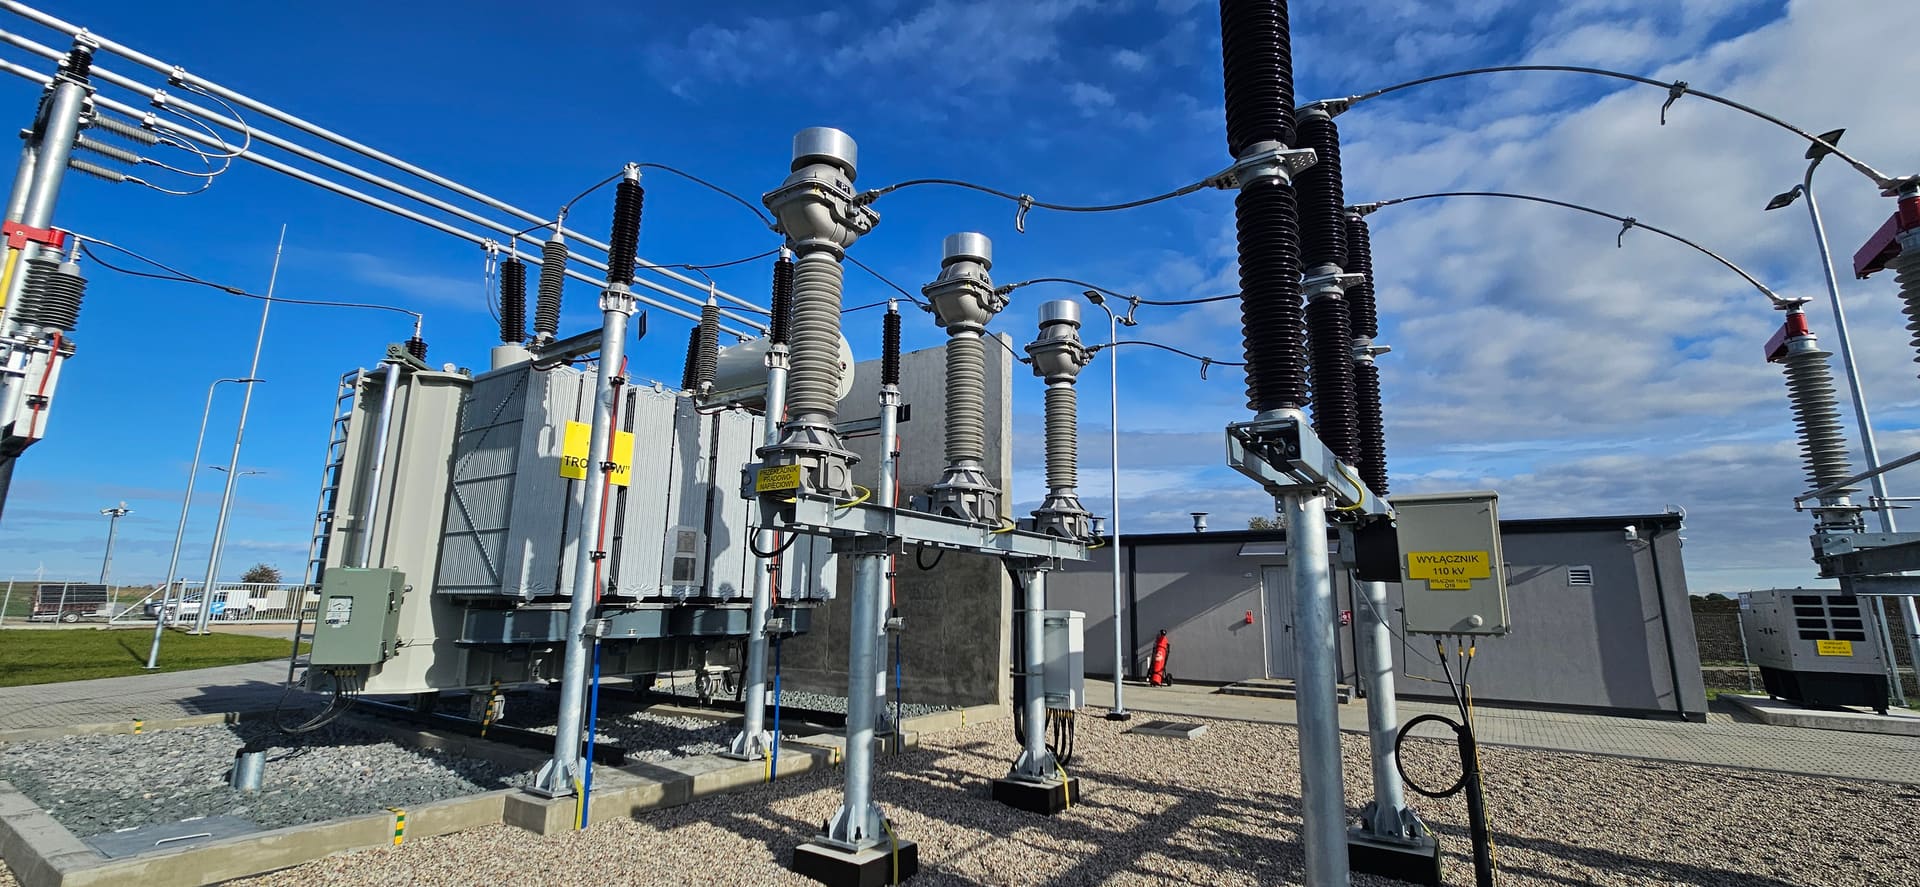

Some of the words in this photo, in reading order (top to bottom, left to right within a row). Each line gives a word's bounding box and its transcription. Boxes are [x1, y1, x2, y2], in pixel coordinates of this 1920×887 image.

[1416, 555, 1479, 565] WYŁĄCZNIK
[1433, 567, 1449, 575] 110
[1452, 567, 1465, 575] kV
